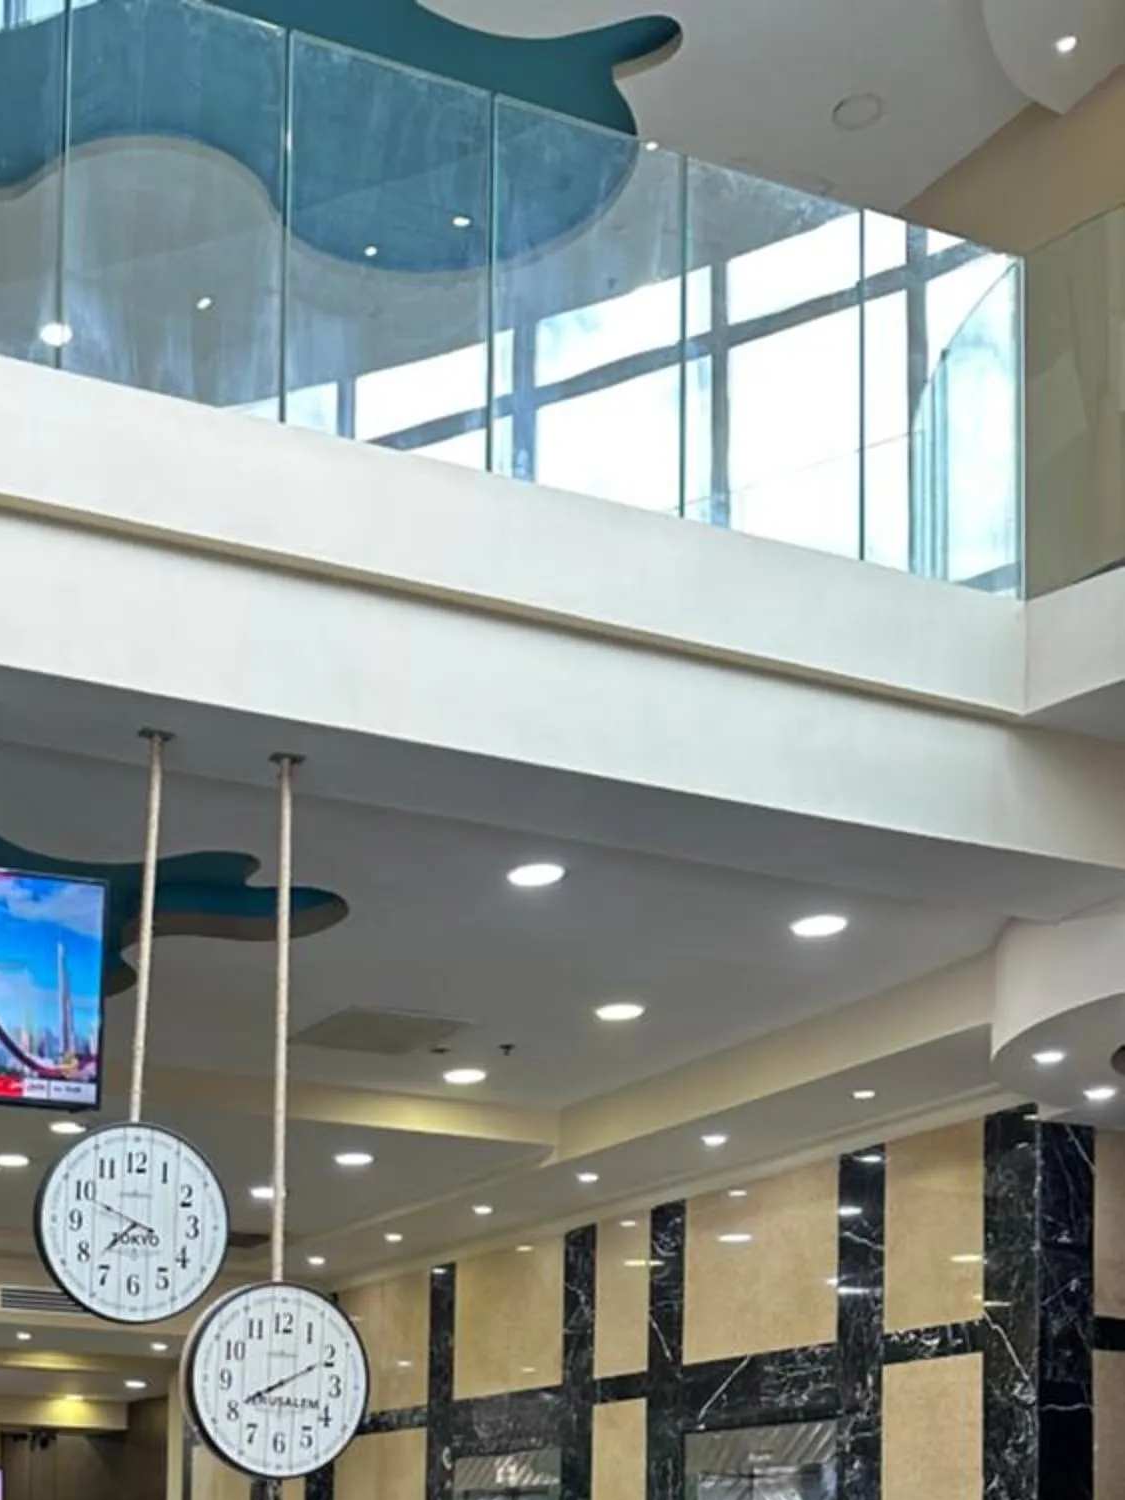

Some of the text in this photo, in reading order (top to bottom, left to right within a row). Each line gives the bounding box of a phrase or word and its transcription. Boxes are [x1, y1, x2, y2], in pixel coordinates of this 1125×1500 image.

[99, 1159, 115, 1179] 11
[127, 1152, 147, 1173] 12
[161, 1162, 168, 1184] 1
[76, 1180, 95, 1201] 10
[180, 1185, 192, 1208] 2
[69, 1210, 83, 1230] 9
[186, 1216, 199, 1238] 3
[112, 1233, 159, 1246] TOKYO
[77, 1241, 89, 1262] 8
[175, 1247, 189, 1269] 4
[98, 1265, 110, 1286] 7
[127, 1275, 140, 1295] 6
[156, 1267, 169, 1289] 5
[249, 1319, 263, 1340] 11
[275, 1313, 293, 1334] 12
[306, 1323, 313, 1344] 1
[226, 1340, 245, 1360] 10
[323, 1345, 335, 1367] 2
[219, 1370, 232, 1390] 9
[328, 1375, 341, 1397] 3
[227, 1400, 239, 1420] 8
[319, 1405, 332, 1427] 4
[246, 1424, 258, 1444] 7
[273, 1433, 285, 1453] 6
[300, 1426, 312, 1448] 5
